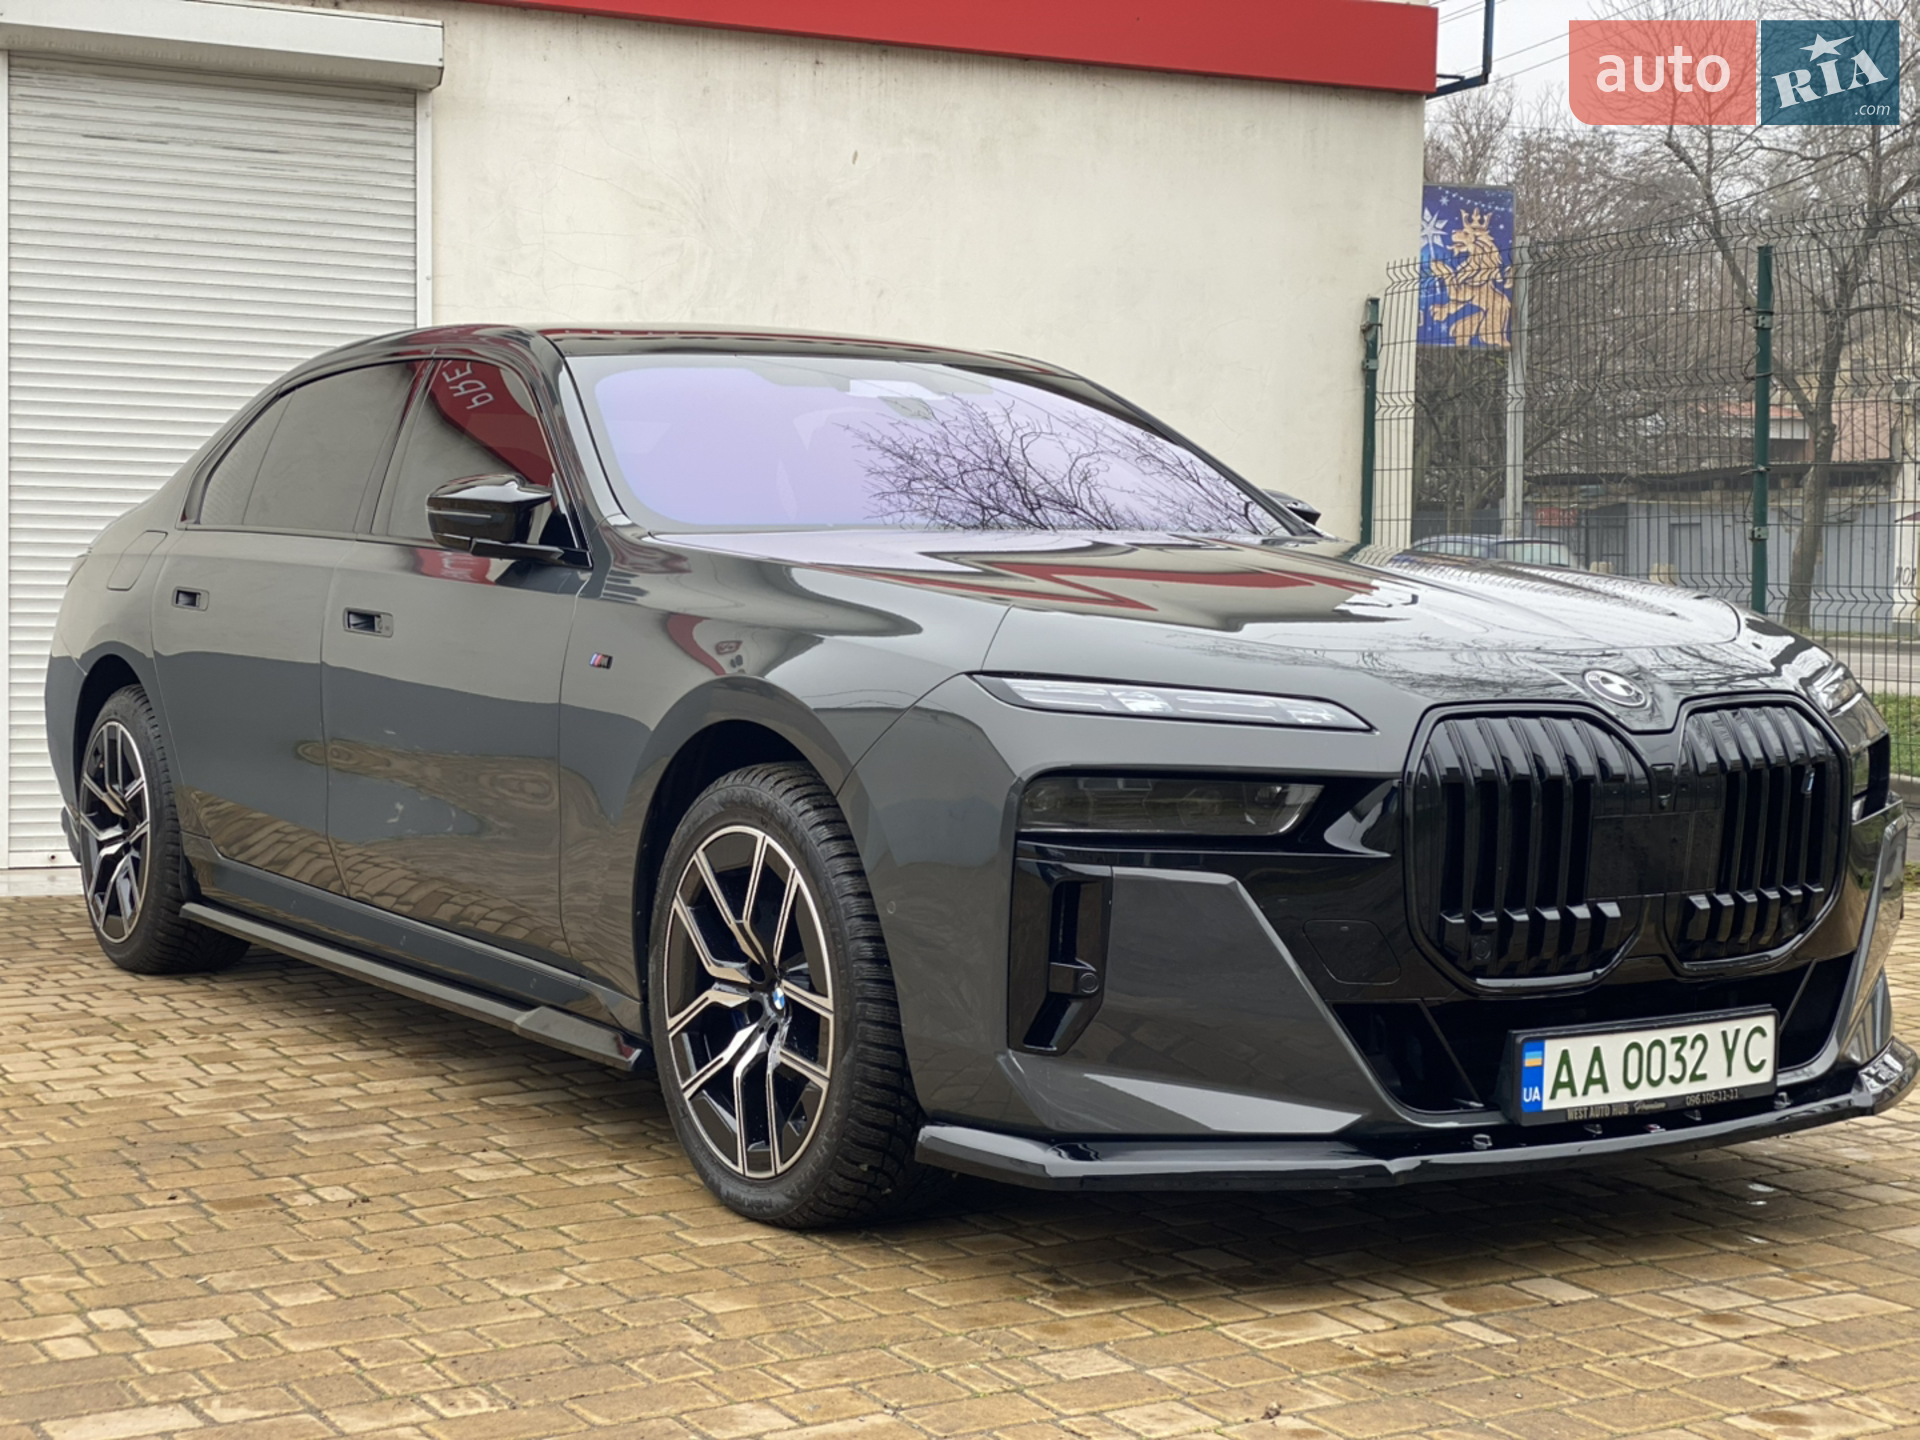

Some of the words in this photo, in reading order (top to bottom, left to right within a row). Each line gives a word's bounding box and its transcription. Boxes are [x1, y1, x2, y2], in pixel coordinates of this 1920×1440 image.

[1549, 1046, 1610, 1100] AA
[1623, 1033, 1708, 1090] 0032
[1721, 1026, 1767, 1077] YC
[1523, 1087, 1541, 1102] UA
[1686, 1096, 1700, 1106] 096
[1567, 1108, 1588, 1120] WEST
[1589, 1106, 1610, 1118] AUTO
[1612, 1104, 1629, 1116] HUB
